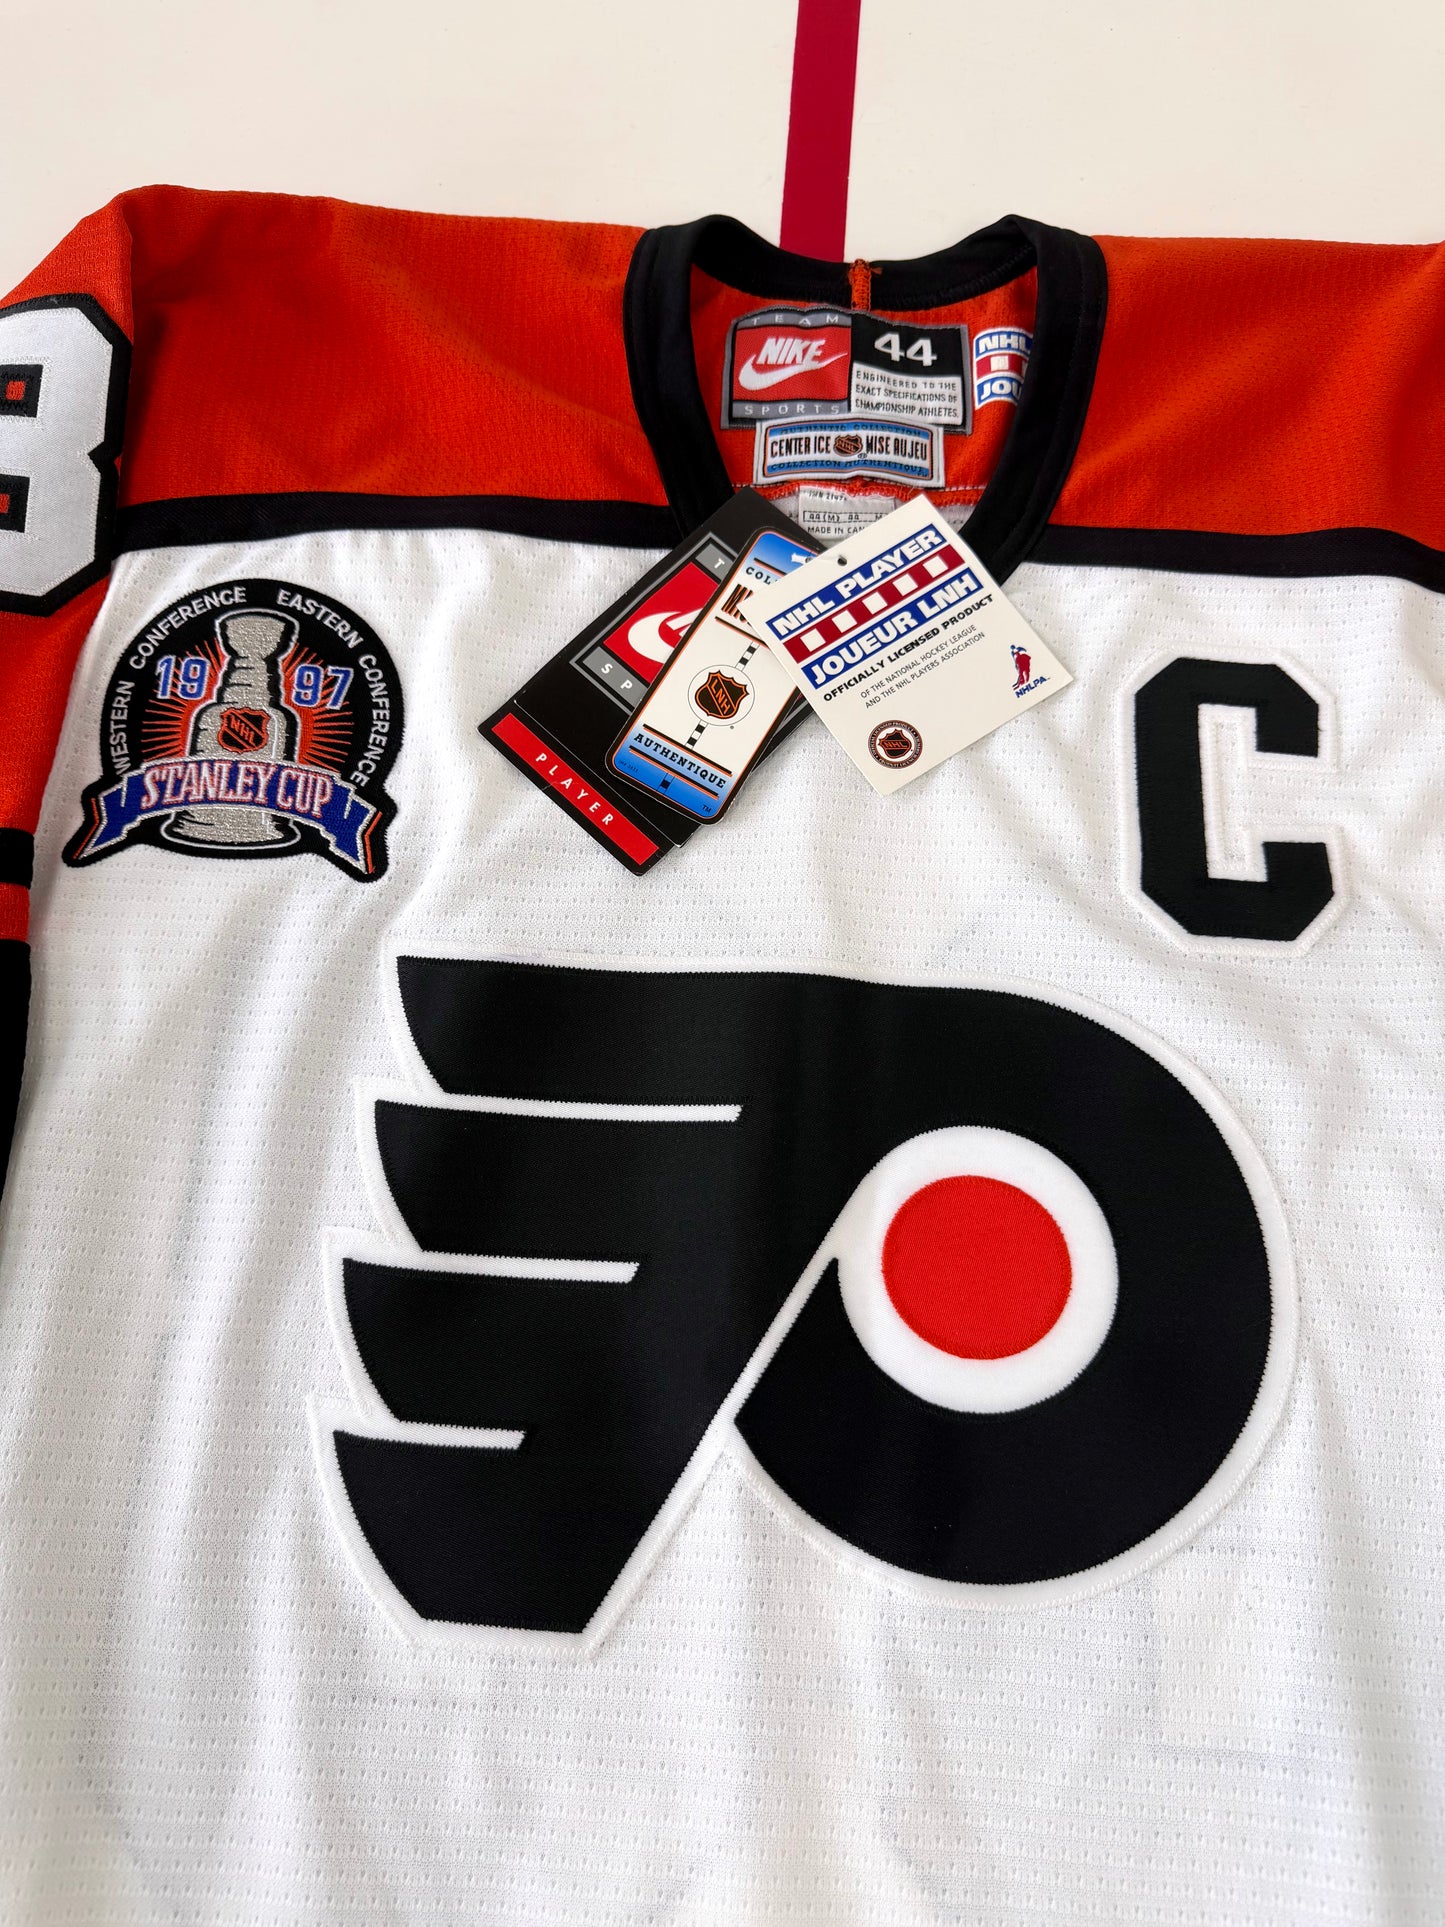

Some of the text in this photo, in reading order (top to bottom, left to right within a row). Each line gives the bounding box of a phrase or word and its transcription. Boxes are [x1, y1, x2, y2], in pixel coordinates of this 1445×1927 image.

[752, 314, 839, 327] TEAM
[756, 337, 826, 366] NIKE
[874, 332, 937, 366] 44
[978, 334, 1030, 354] NHL
[855, 384, 957, 403] EXACT SPECIFICATIONS OF
[856, 370, 917, 389] ENGINEERED
[938, 382, 956, 391] THE
[744, 404, 840, 416] SPORTS
[855, 399, 915, 414] CHAMPIONSHIP
[771, 435, 831, 458] CENTER ICE
[853, 424, 921, 436] COLLECTION
[866, 435, 890, 454] MISE
[771, 460, 841, 470] COLLECTION
[808, 526, 831, 534] MADE
[834, 527, 843, 535] IN
[746, 566, 777, 585] COL
[771, 530, 942, 637] NHL PLAYER
[811, 573, 978, 685] JOUEUR LNH
[823, 594, 994, 702] OFFICIALLY LICENSED PRODUCT
[860, 624, 977, 699] OF THE NATIONAL HOCKEY LEAGUE
[109, 587, 247, 776] WESTERN CONFERENCE
[156, 655, 354, 710] 19 97
[865, 632, 986, 709] AND THE NHL PLAYERS ASSOCIATION
[1015, 676, 1047, 698] NHLPA
[278, 589, 390, 787] EASTERN CONFERENCE
[710, 679, 731, 713] LNH
[231, 714, 256, 748] NHL
[633, 732, 727, 789] AUTHENTIQUE
[141, 761, 334, 818] STANLEY CUP
[535, 752, 614, 825] PLAYER
[1134, 656, 1335, 941] C
